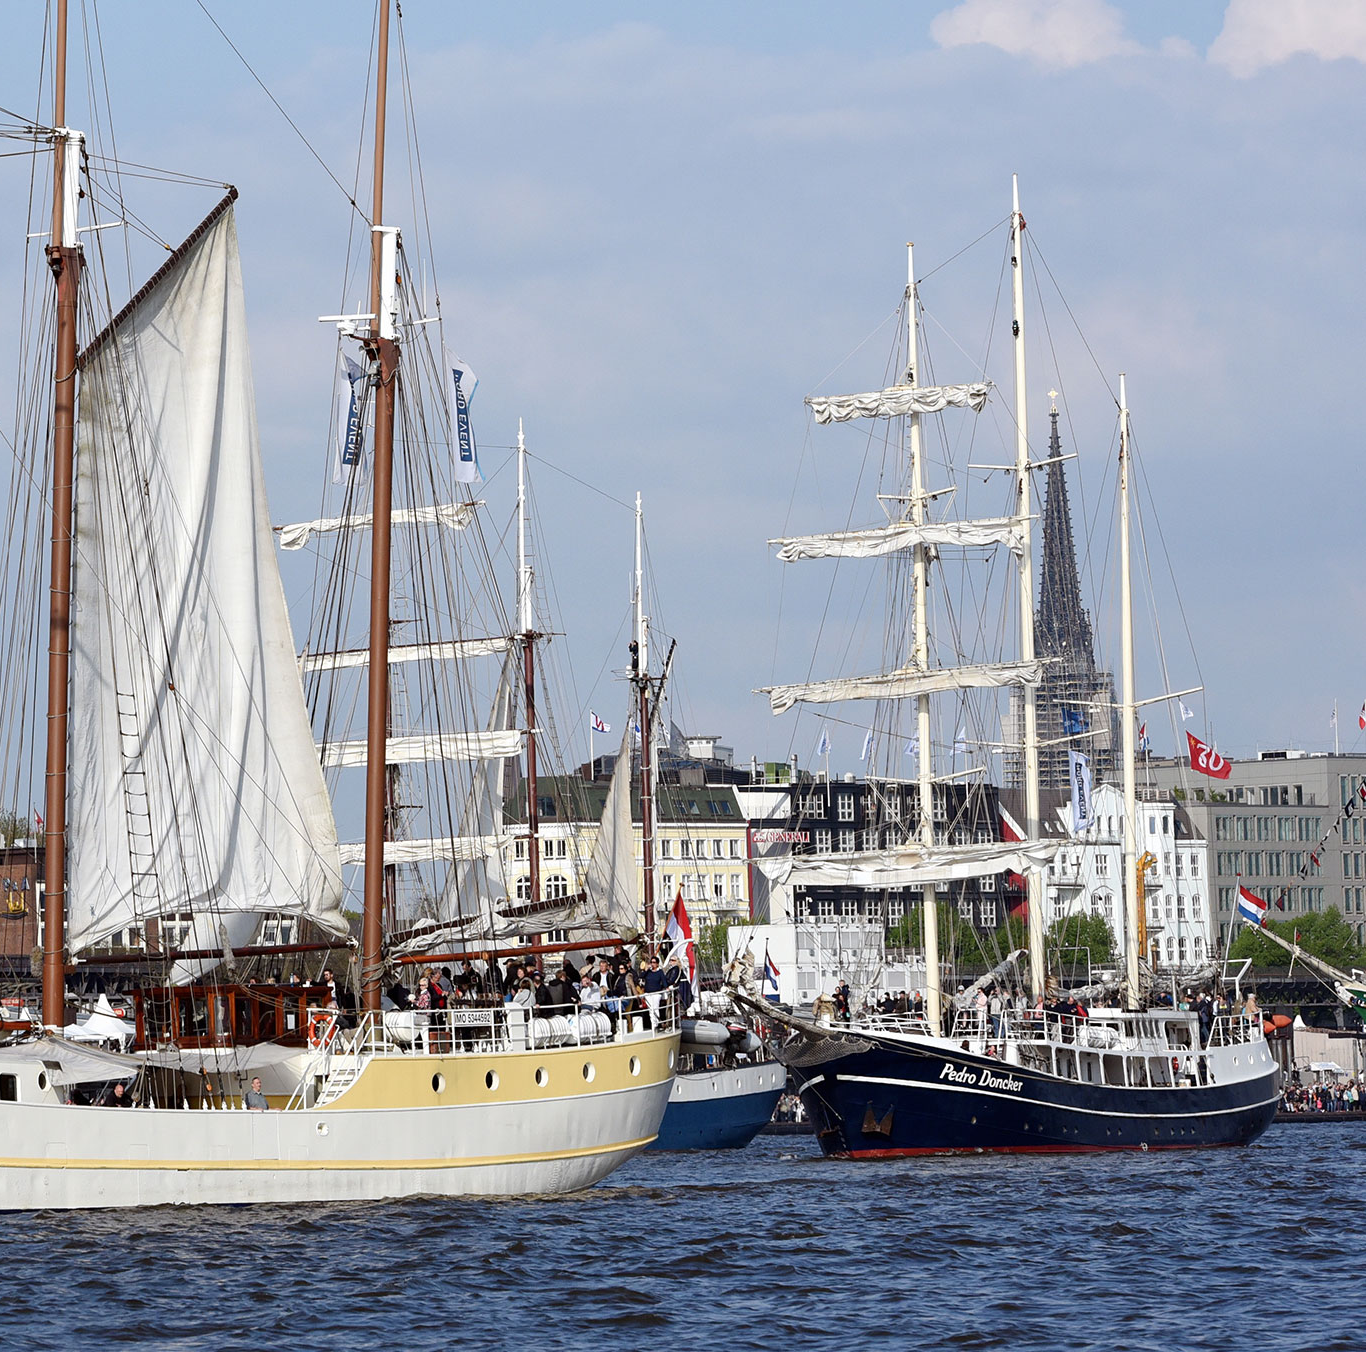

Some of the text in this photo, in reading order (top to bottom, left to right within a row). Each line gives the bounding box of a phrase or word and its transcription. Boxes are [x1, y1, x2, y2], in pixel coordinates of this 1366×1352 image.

[767, 831, 810, 843] GENERALI
[939, 1063, 1023, 1092] Pedro Doncker
